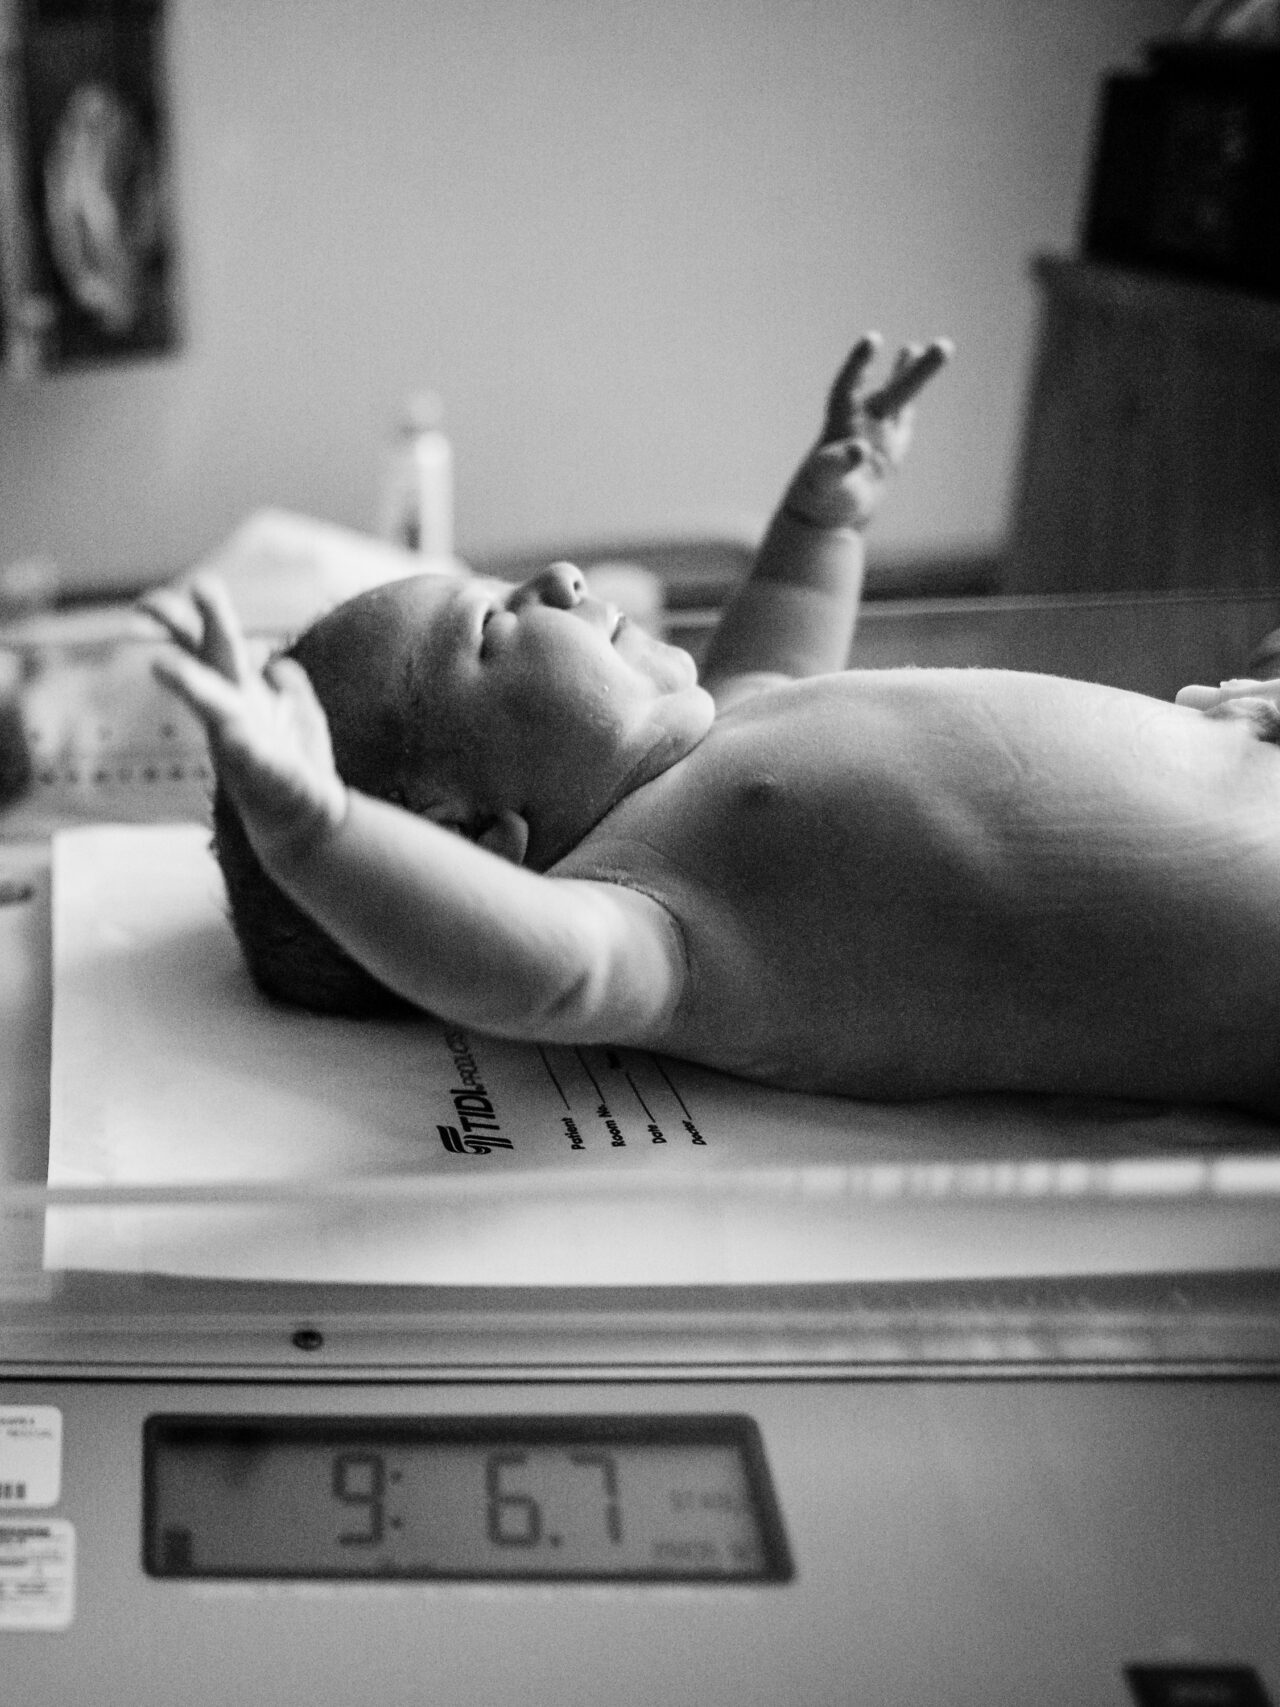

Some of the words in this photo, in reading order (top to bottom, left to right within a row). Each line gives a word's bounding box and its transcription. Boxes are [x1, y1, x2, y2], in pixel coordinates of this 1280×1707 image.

[450, 1088, 500, 1132] TIDI
[596, 1104, 613, 1118] No.
[561, 1117, 587, 1150] Patient
[605, 1120, 626, 1147] Room
[647, 1124, 668, 1144] Date
[682, 1120, 708, 1145] Doctor
